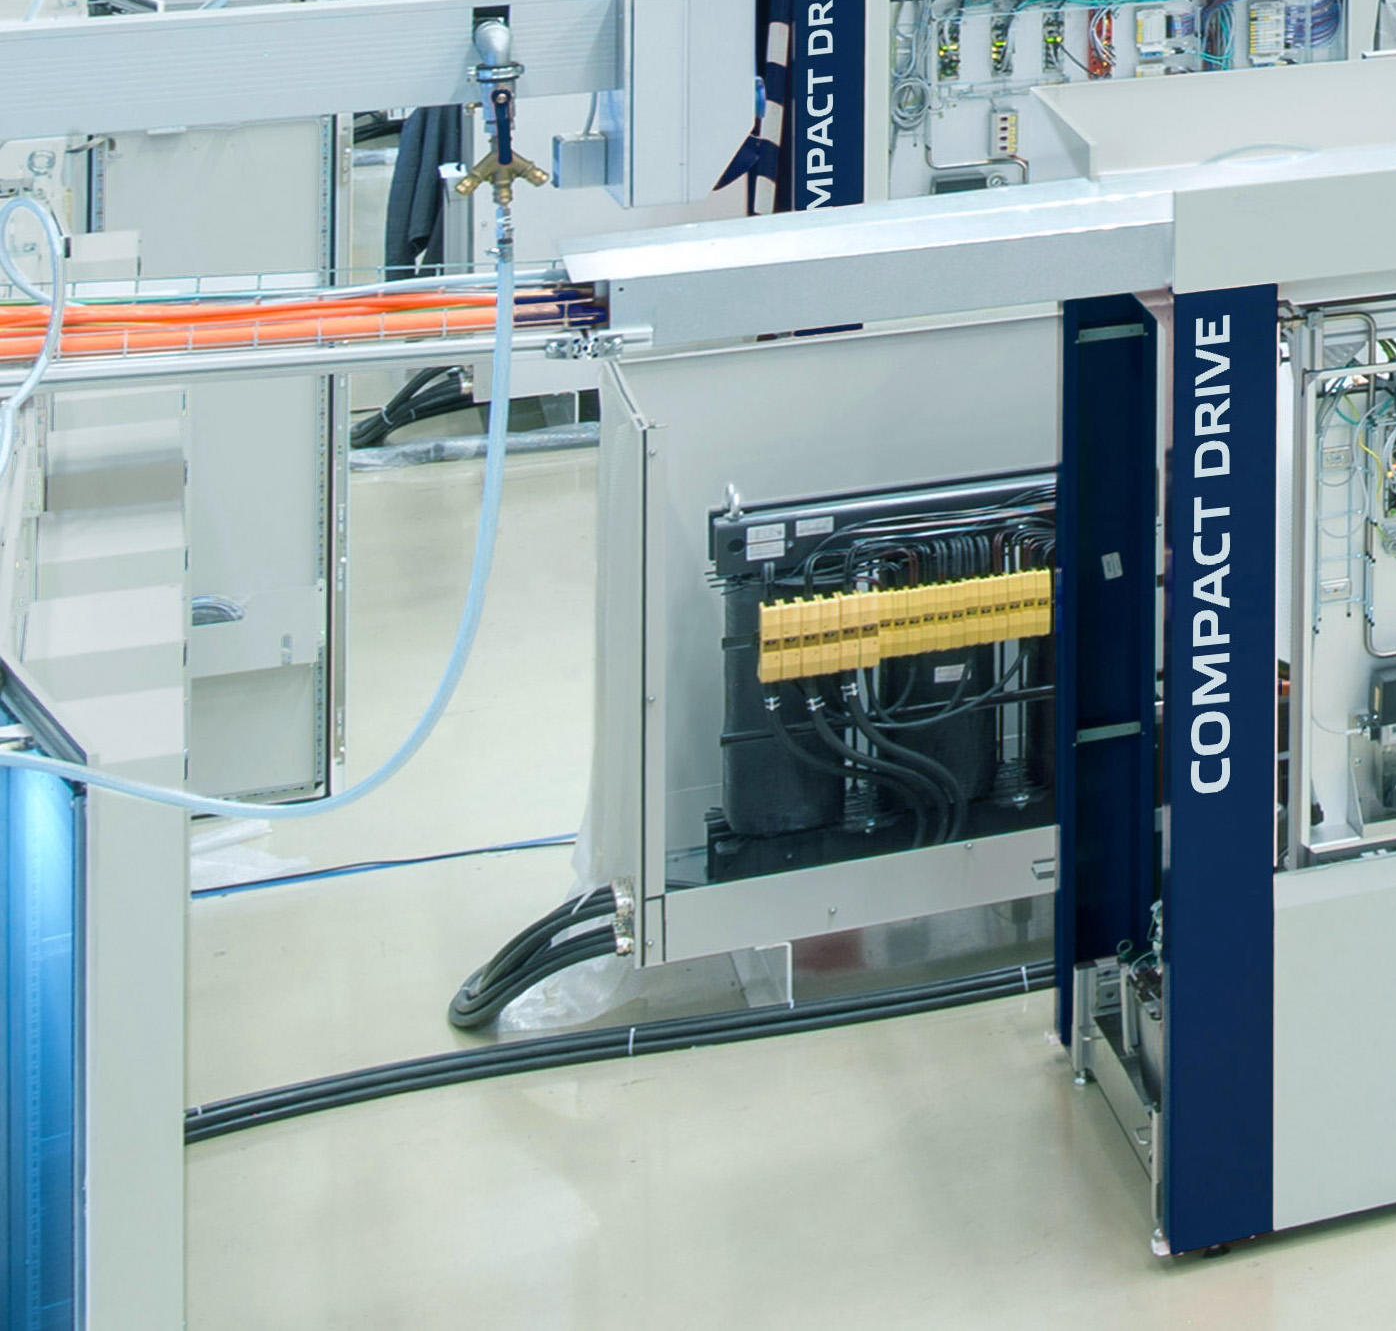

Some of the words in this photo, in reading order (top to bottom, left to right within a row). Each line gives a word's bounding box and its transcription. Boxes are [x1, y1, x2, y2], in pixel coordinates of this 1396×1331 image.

[806, 68, 834, 211] MPACT
[1193, 313, 1231, 480] DRIVE
[1190, 495, 1231, 796] COMPACT
